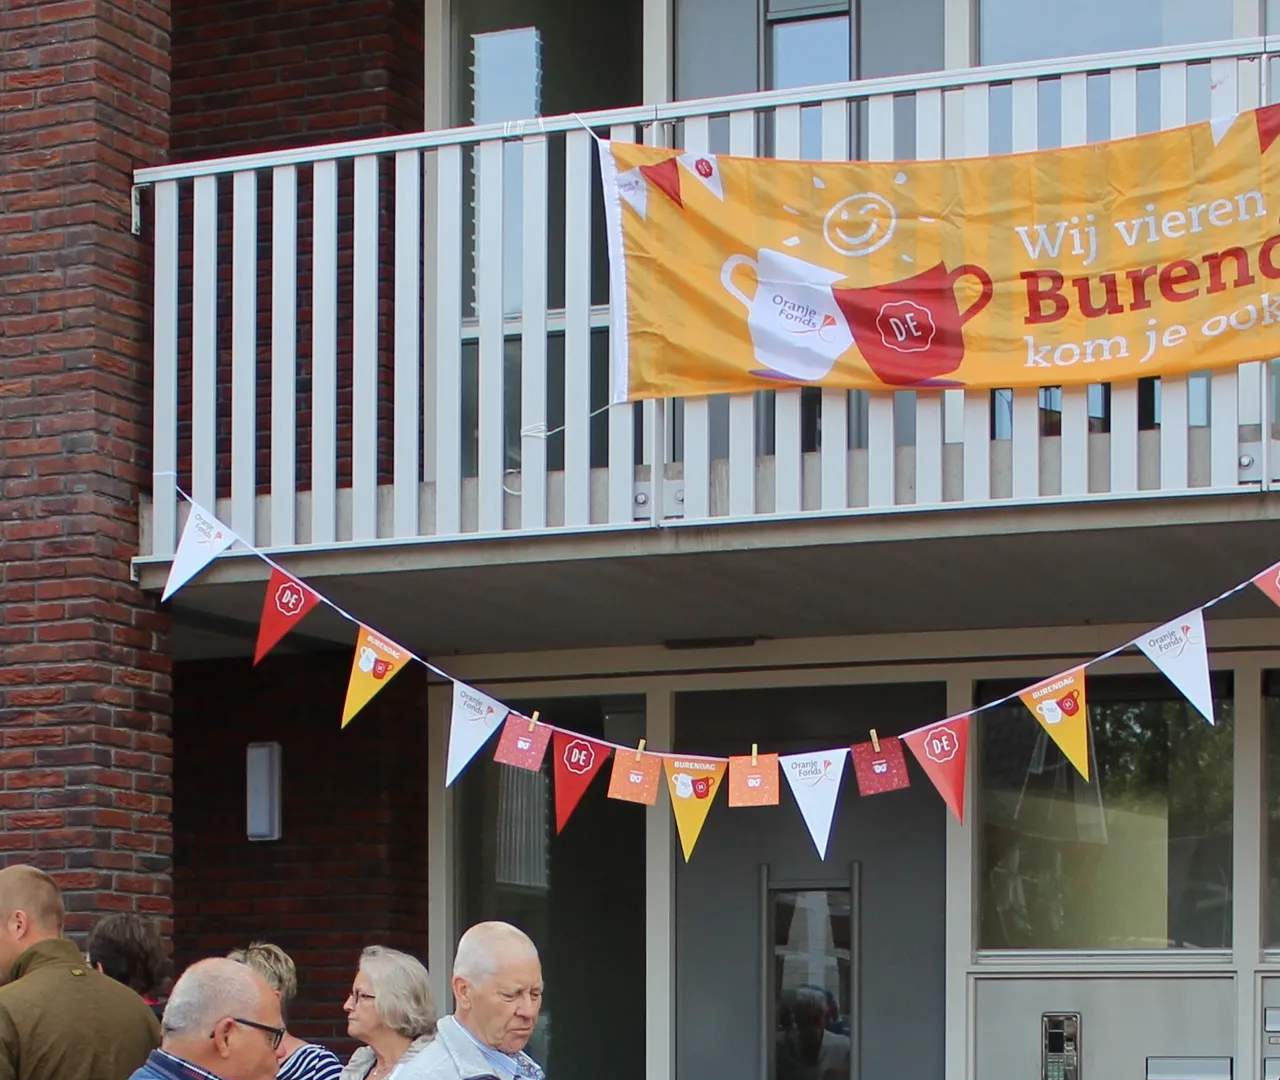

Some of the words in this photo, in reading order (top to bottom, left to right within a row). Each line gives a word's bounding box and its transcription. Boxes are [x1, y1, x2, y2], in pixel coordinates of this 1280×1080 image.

[1015, 214, 1097, 266] Wij
[1114, 189, 1267, 247] vieren
[772, 294, 817, 318] Oranje
[778, 308, 818, 329] Fonds
[1023, 334, 1130, 369] kom
[1139, 318, 1187, 363] je
[1148, 629, 1177, 648] Oranje
[1158, 636, 1184, 653] Fonds
[1032, 676, 1075, 699] BURENDAG
[460, 690, 484, 707] Oranje
[463, 700, 484, 716] Fonds
[674, 760, 716, 771] BURENDAG
[791, 760, 819, 772] Oranje
[798, 767, 822, 777] Fonds
